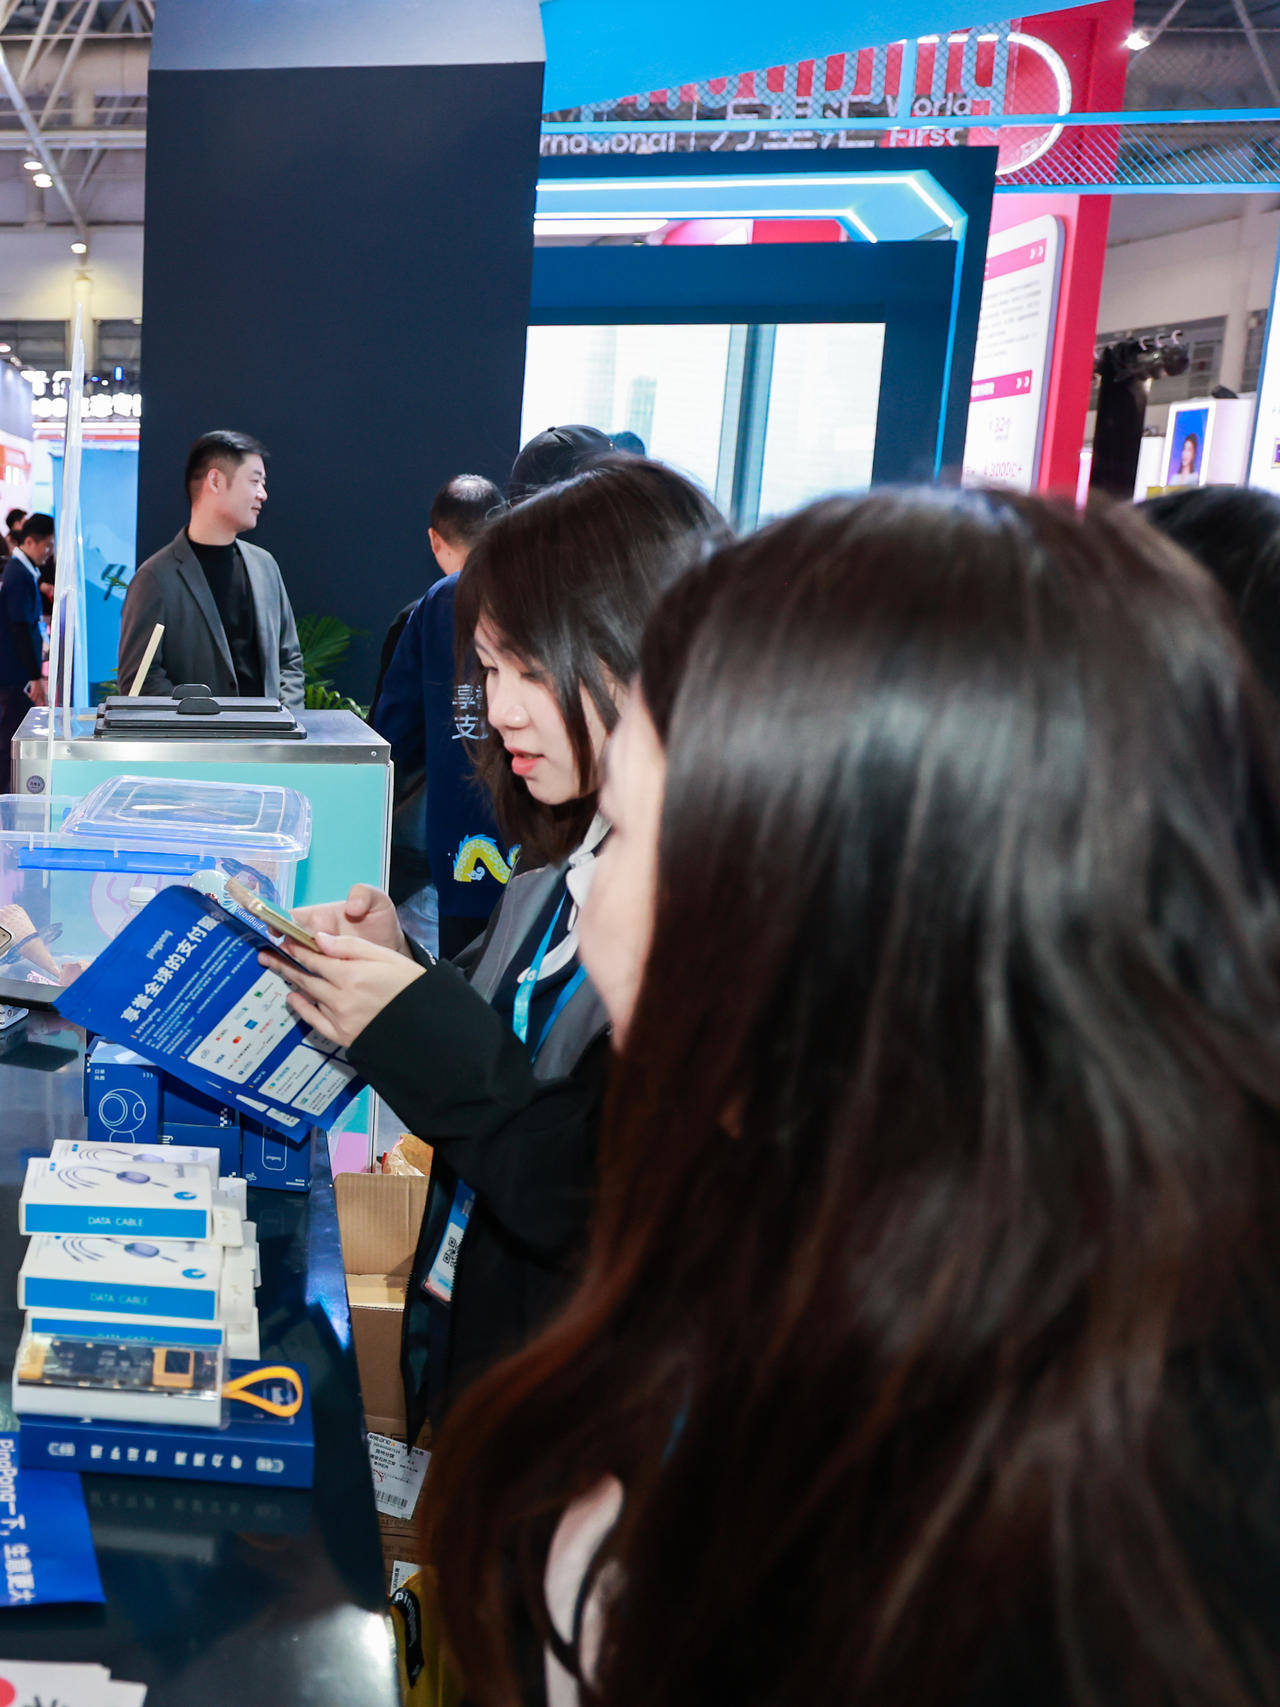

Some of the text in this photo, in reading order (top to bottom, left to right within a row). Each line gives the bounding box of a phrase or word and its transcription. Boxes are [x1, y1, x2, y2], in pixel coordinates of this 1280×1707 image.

[88, 1216, 144, 1227] DATA CABLE
[90, 1293, 149, 1306] DATA CABLE
